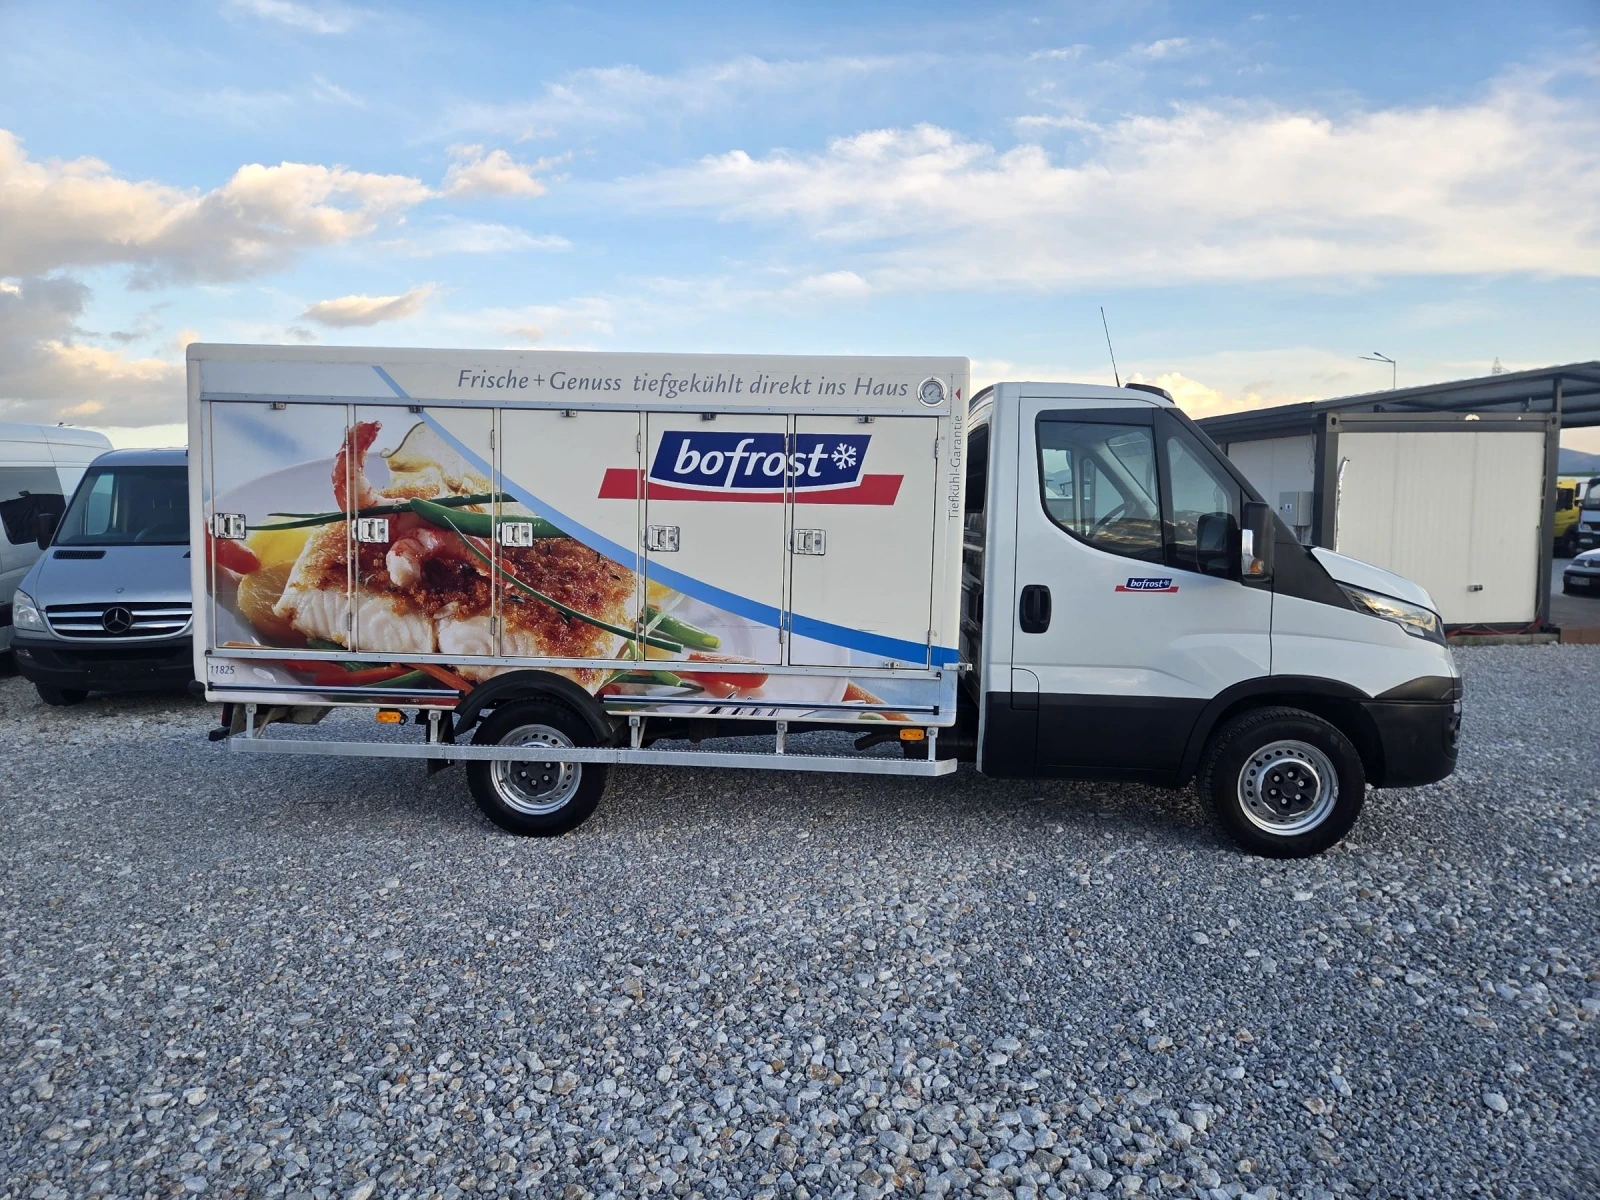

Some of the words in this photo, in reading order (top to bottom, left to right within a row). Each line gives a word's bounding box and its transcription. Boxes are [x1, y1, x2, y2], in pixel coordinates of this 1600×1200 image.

[458, 369, 529, 389] Frische
[550, 371, 622, 391] Genuss
[633, 372, 743, 399] tiefgekühlt
[749, 374, 812, 395] direkt
[817, 376, 847, 396] ins
[854, 377, 909, 396] Haus
[673, 438, 828, 488] bofrost
[948, 415, 963, 521] Tiefkühl-Garantie
[1130, 579, 1163, 589] bofrost
[210, 665, 235, 675] 11825
